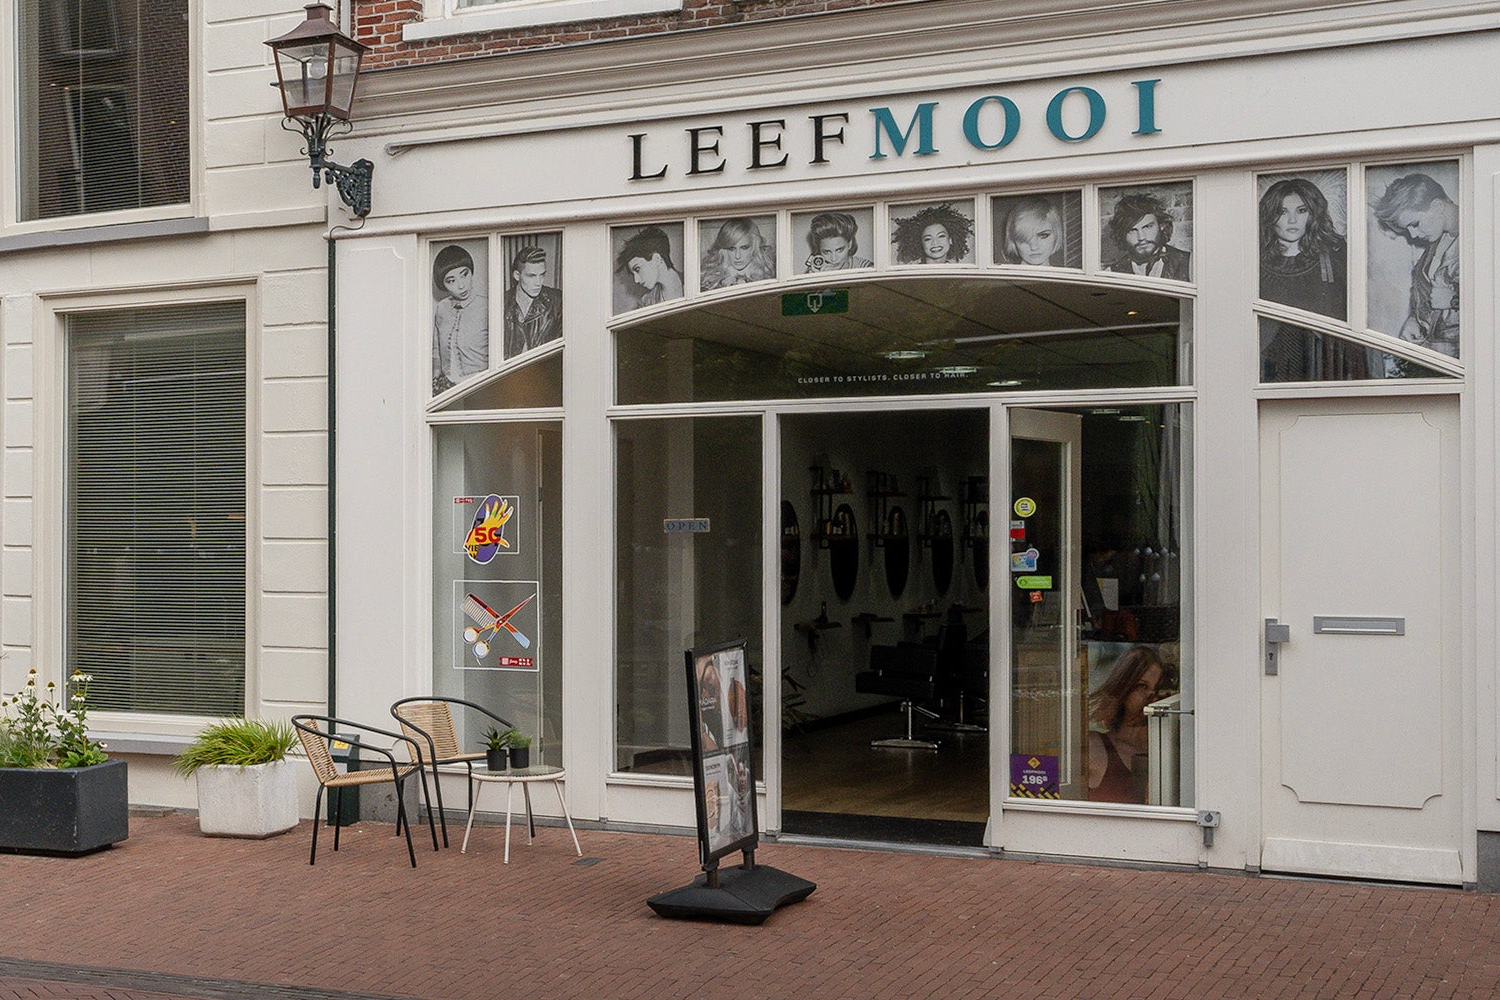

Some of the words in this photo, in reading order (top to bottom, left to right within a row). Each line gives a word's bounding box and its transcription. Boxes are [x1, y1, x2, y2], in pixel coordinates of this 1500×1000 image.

[627, 78, 1162, 182] LEEFMOOI
[797, 376, 830, 384] CLOSER
[846, 374, 891, 382] STYLISTS.
[892, 373, 927, 381] CLOSER
[666, 521, 707, 531] OPEN
